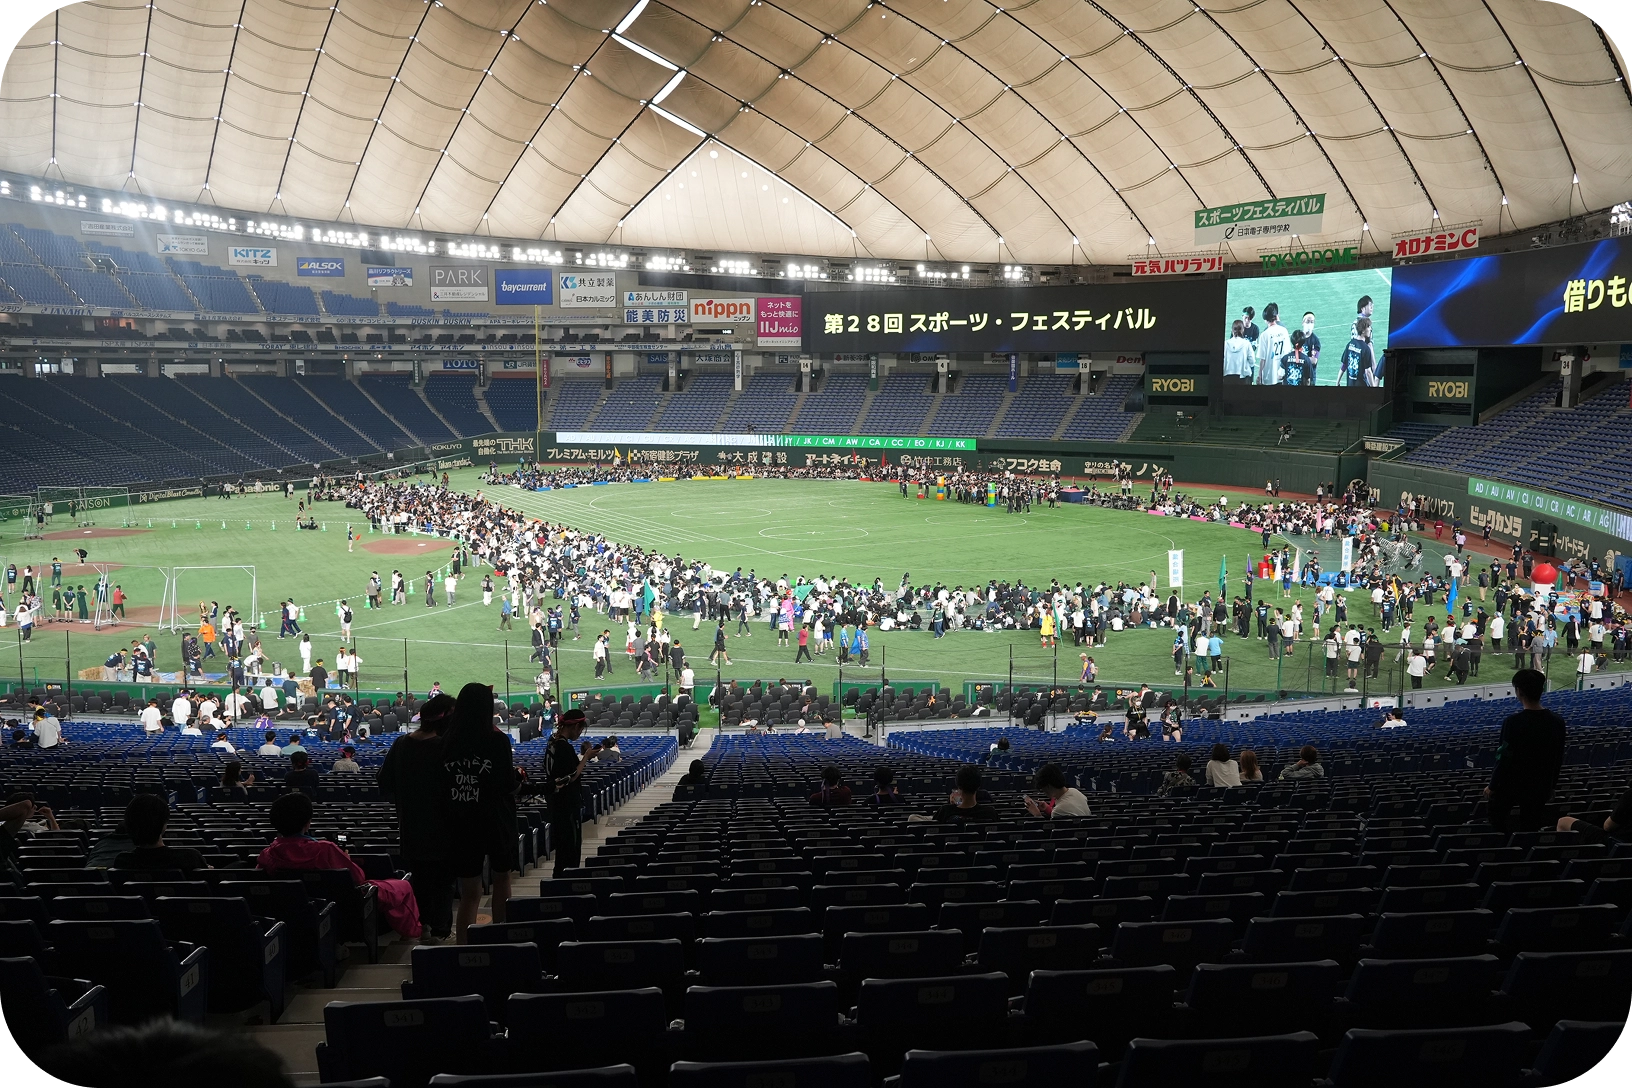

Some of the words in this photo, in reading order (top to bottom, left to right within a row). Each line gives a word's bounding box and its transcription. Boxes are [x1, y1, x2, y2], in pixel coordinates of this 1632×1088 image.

[1198, 197, 1320, 226] スポーツフェスティバル
[1237, 223, 1290, 237] 日本電子専門学校
[1395, 228, 1477, 257] オロナミンC
[234, 249, 272, 259] KITZ
[1259, 251, 1309, 271] TOKYO
[1311, 246, 1358, 268] DOME
[307, 262, 342, 270] ALSOK
[1133, 256, 1223, 275] 元気ハツラツ!
[435, 269, 482, 284] PARK
[501, 280, 547, 293] baycurrent
[578, 278, 614, 288] 共立製薬
[576, 295, 615, 303] 日本カルミック
[635, 292, 684, 301] あんしん財団
[1563, 275, 1632, 313] 借りも
[694, 300, 750, 318] nippn
[767, 301, 792, 309] ネットを
[626, 309, 687, 323] 能美防災
[760, 310, 798, 318] もっと快適に
[909, 307, 1156, 334] スポーツ・フェスティバル
[445, 360, 478, 368] TOTO
[696, 354, 731, 362] 大塚商会
[1562, 361, 1570, 369] 34
[1152, 378, 1194, 392] RYOBI
[1428, 381, 1468, 398] RYOBI
[432, 443, 462, 451] KOKUYO
[496, 438, 534, 451] THK
[845, 438, 858, 446] AW
[891, 439, 904, 447] CC
[546, 449, 615, 459] プレミアム・モルツ
[640, 450, 699, 461] 新宿健診プラザ
[732, 451, 788, 463] 大成建設
[805, 453, 878, 465] アートネイチー
[1006, 458, 1062, 472] フコク生命
[1084, 461, 1113, 469] 守りの名
[1474, 482, 1484, 493] AD
[1490, 485, 1499, 497] AU
[1505, 489, 1515, 500] AV
[1522, 493, 1529, 504] CI
[1535, 496, 1543, 508] CU
[1550, 500, 1559, 513] CR
[1566, 504, 1575, 518] AC
[1582, 509, 1591, 522] AR
[1470, 505, 1523, 538] ビックカメラ
[455, 774, 479, 785] ONE
